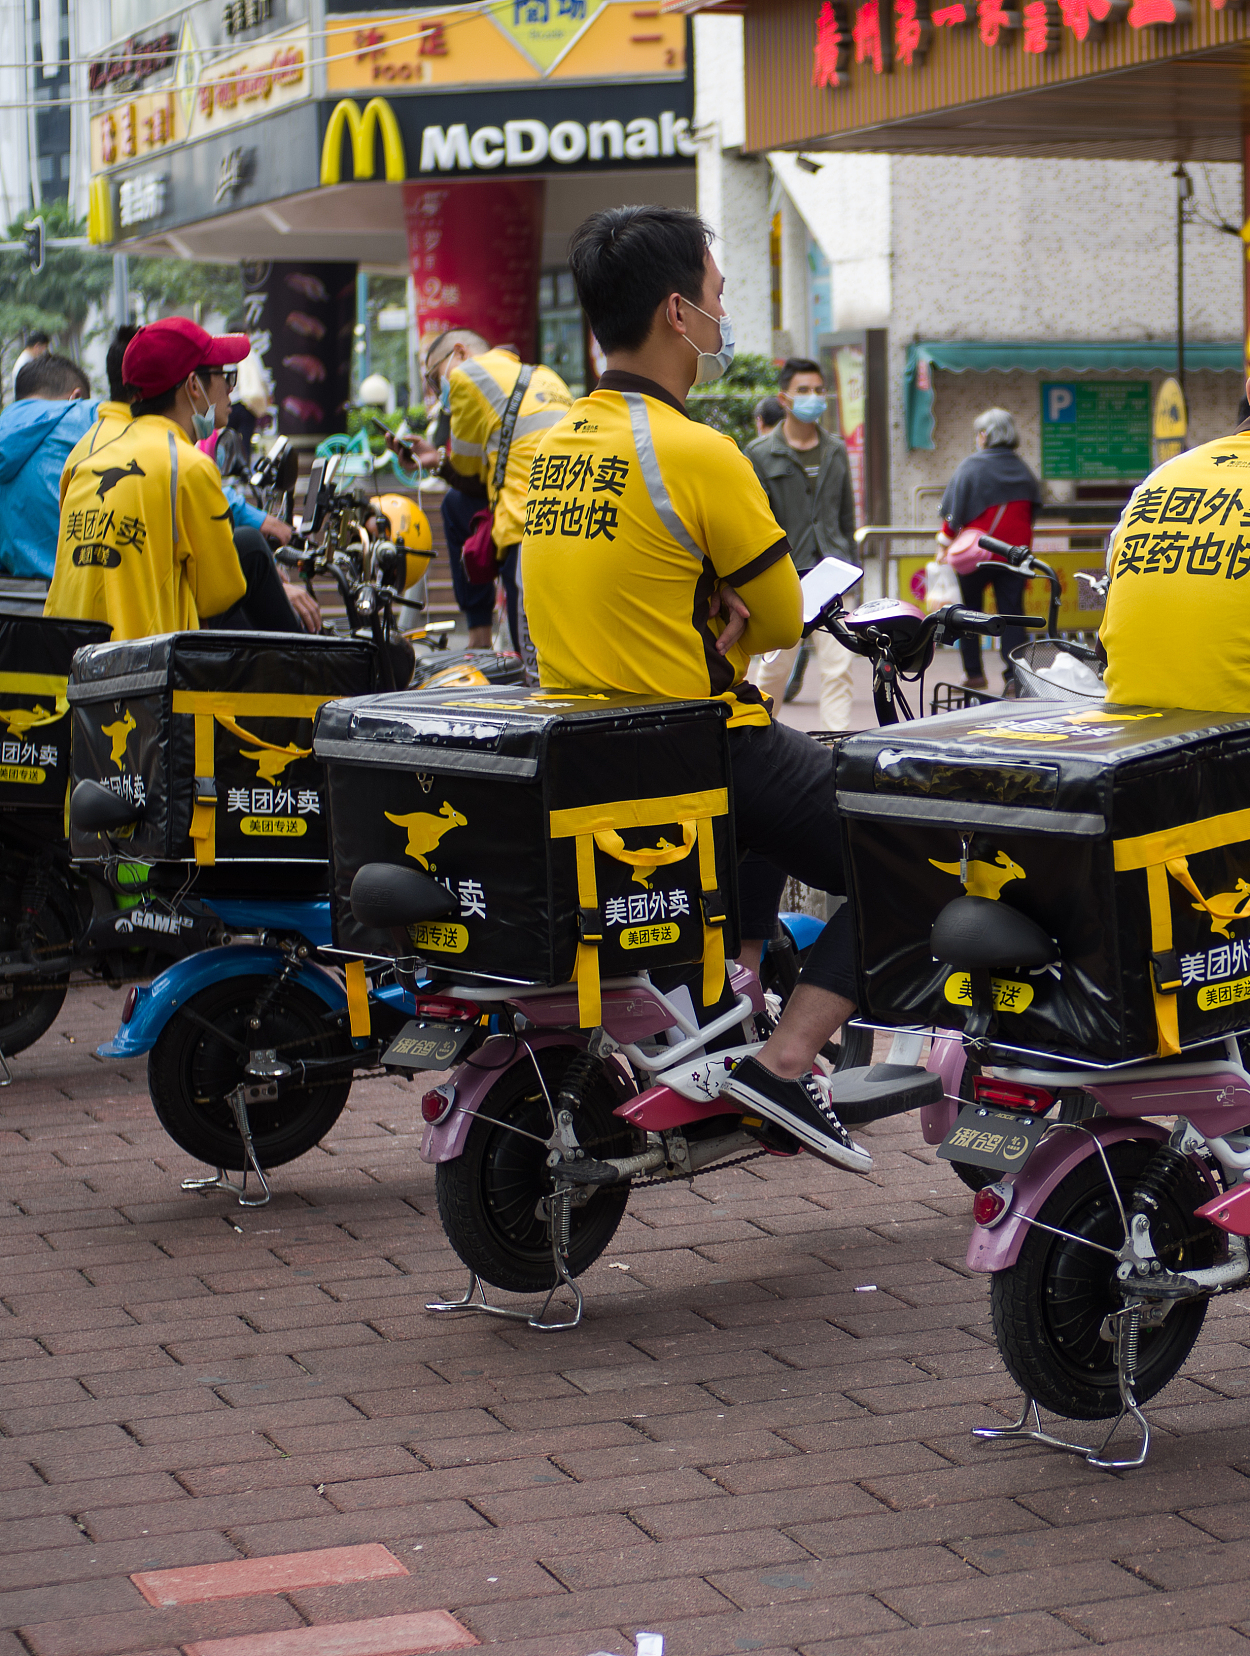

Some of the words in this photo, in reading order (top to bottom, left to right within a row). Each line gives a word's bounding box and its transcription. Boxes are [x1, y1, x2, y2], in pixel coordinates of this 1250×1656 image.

[1049, 387, 1072, 421] P
[526, 453, 629, 497] 美团外卖
[66, 509, 147, 554] 美团外卖
[0, 741, 58, 768] 团外卖
[226, 787, 321, 815] 美团外卖
[249, 819, 299, 833] 美团专送
[605, 888, 691, 927] 美团外卖
[627, 925, 673, 947] 美团专送
[948, 1126, 1004, 1153] 傲鸽
